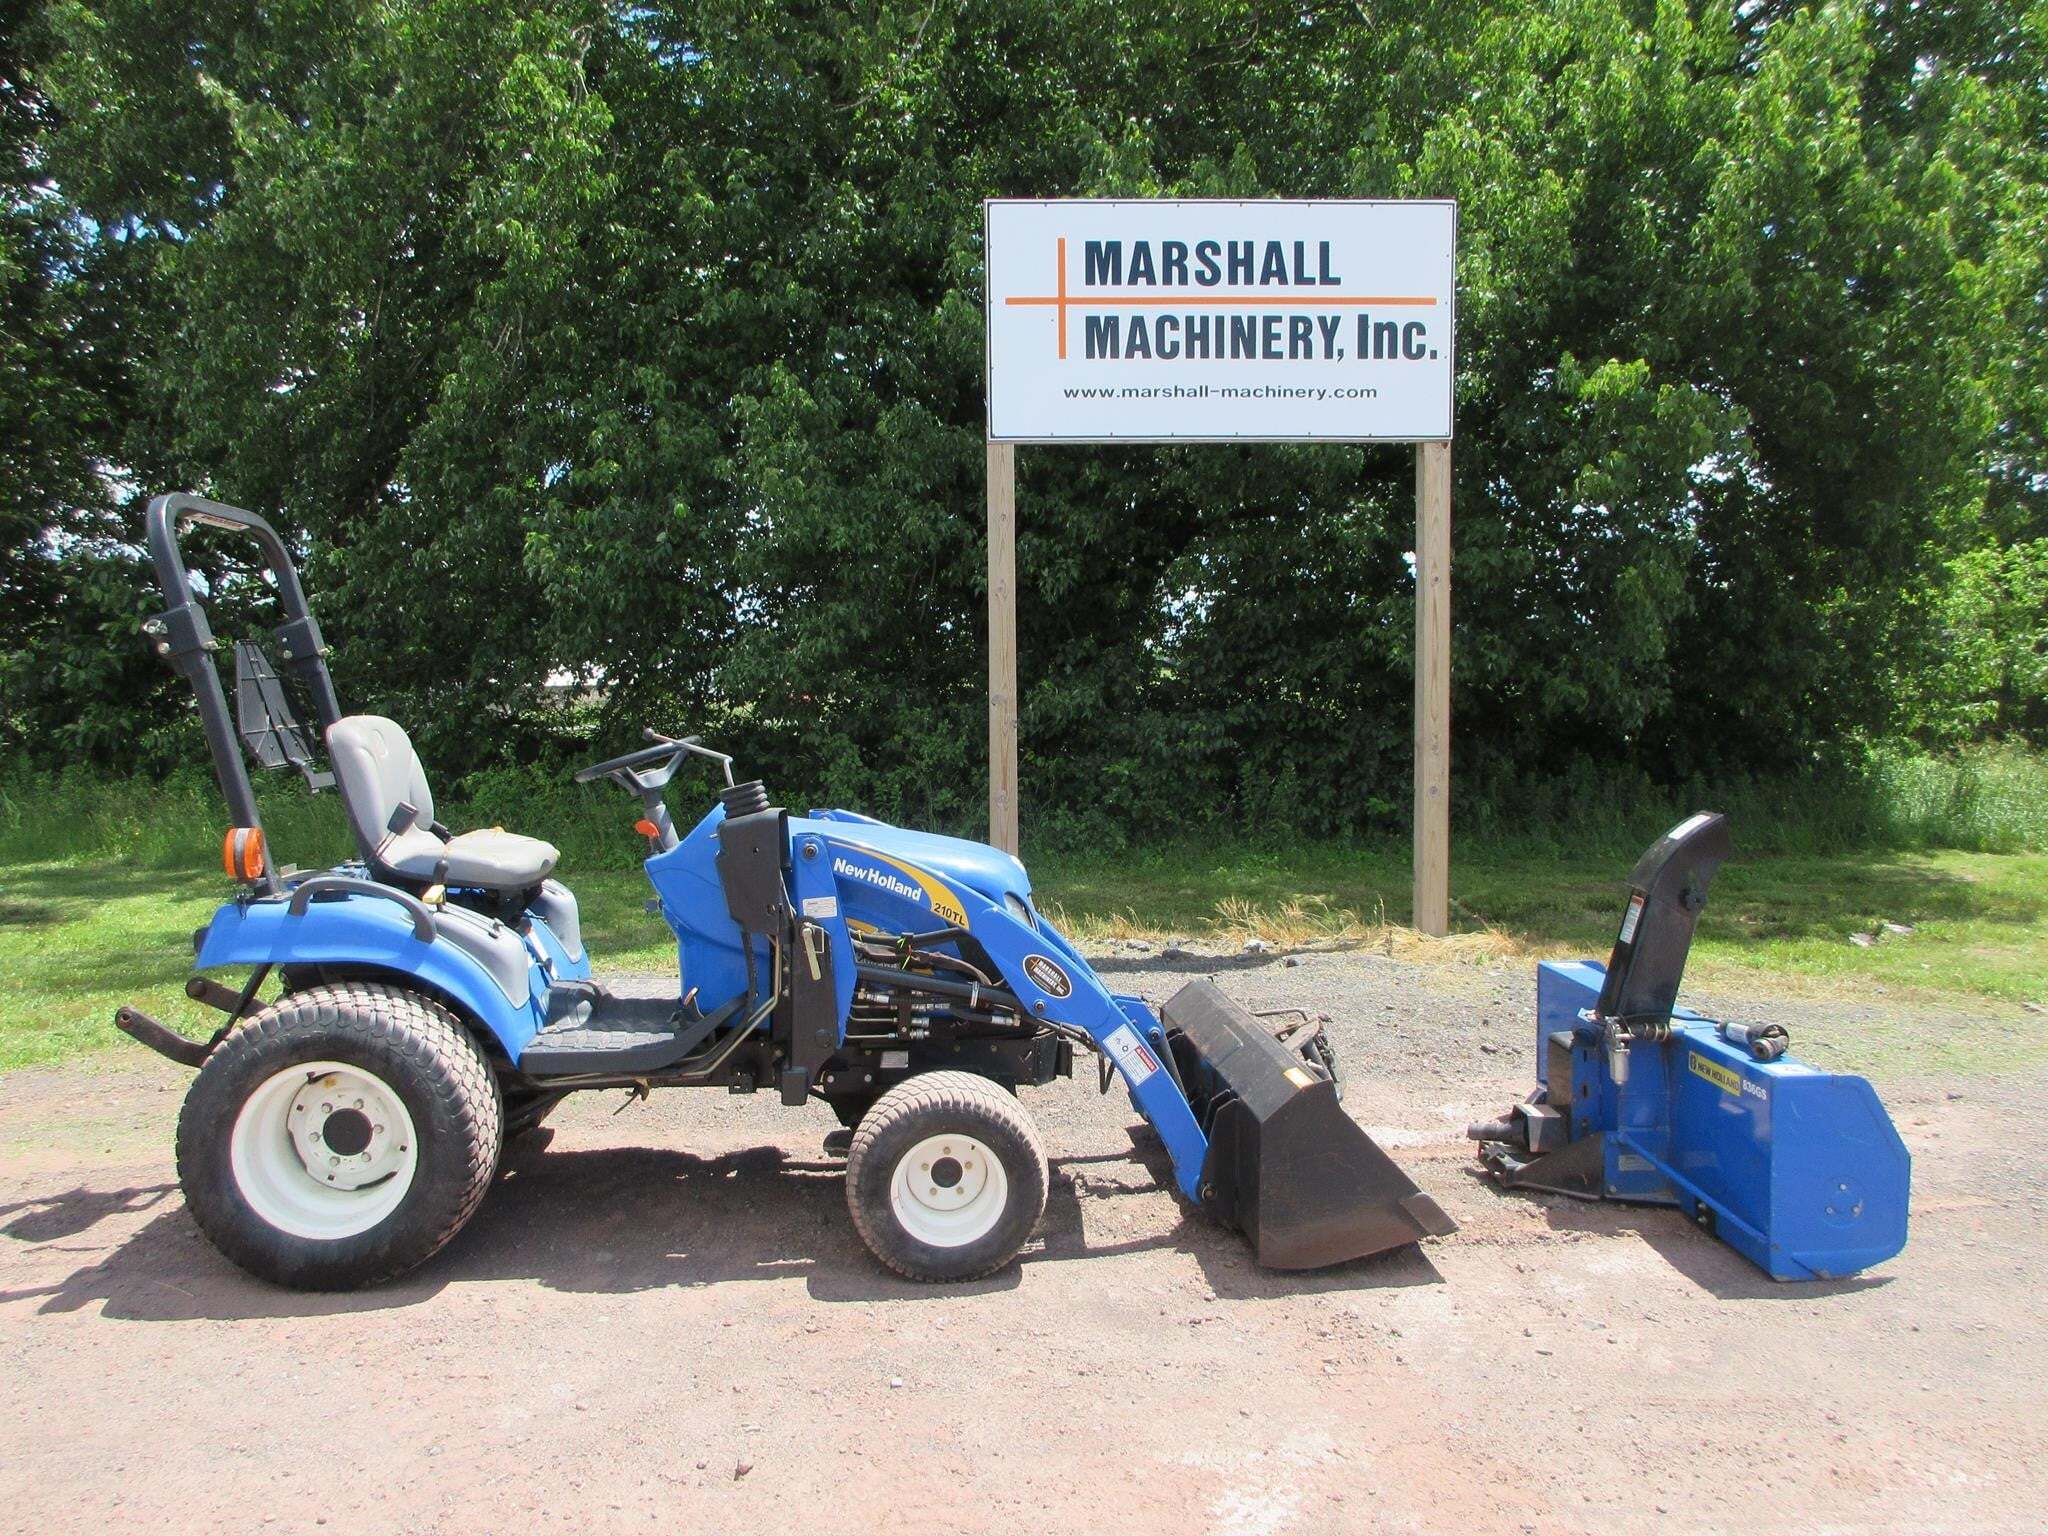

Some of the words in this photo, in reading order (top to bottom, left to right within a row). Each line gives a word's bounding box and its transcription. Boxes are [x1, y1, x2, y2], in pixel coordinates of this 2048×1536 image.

[1084, 240, 1342, 287] MARSHALL
[1085, 314, 1345, 363] MACHINERY,
[1356, 313, 1438, 360] Inc.
[1063, 385, 1378, 401] www.marshall-machinery.com
[833, 857, 868, 880] New
[867, 868, 923, 901] Holland
[934, 902, 966, 926] 210TL
[1697, 1062, 1711, 1077] NEW
[1711, 1069, 1741, 1092] HOLLAND
